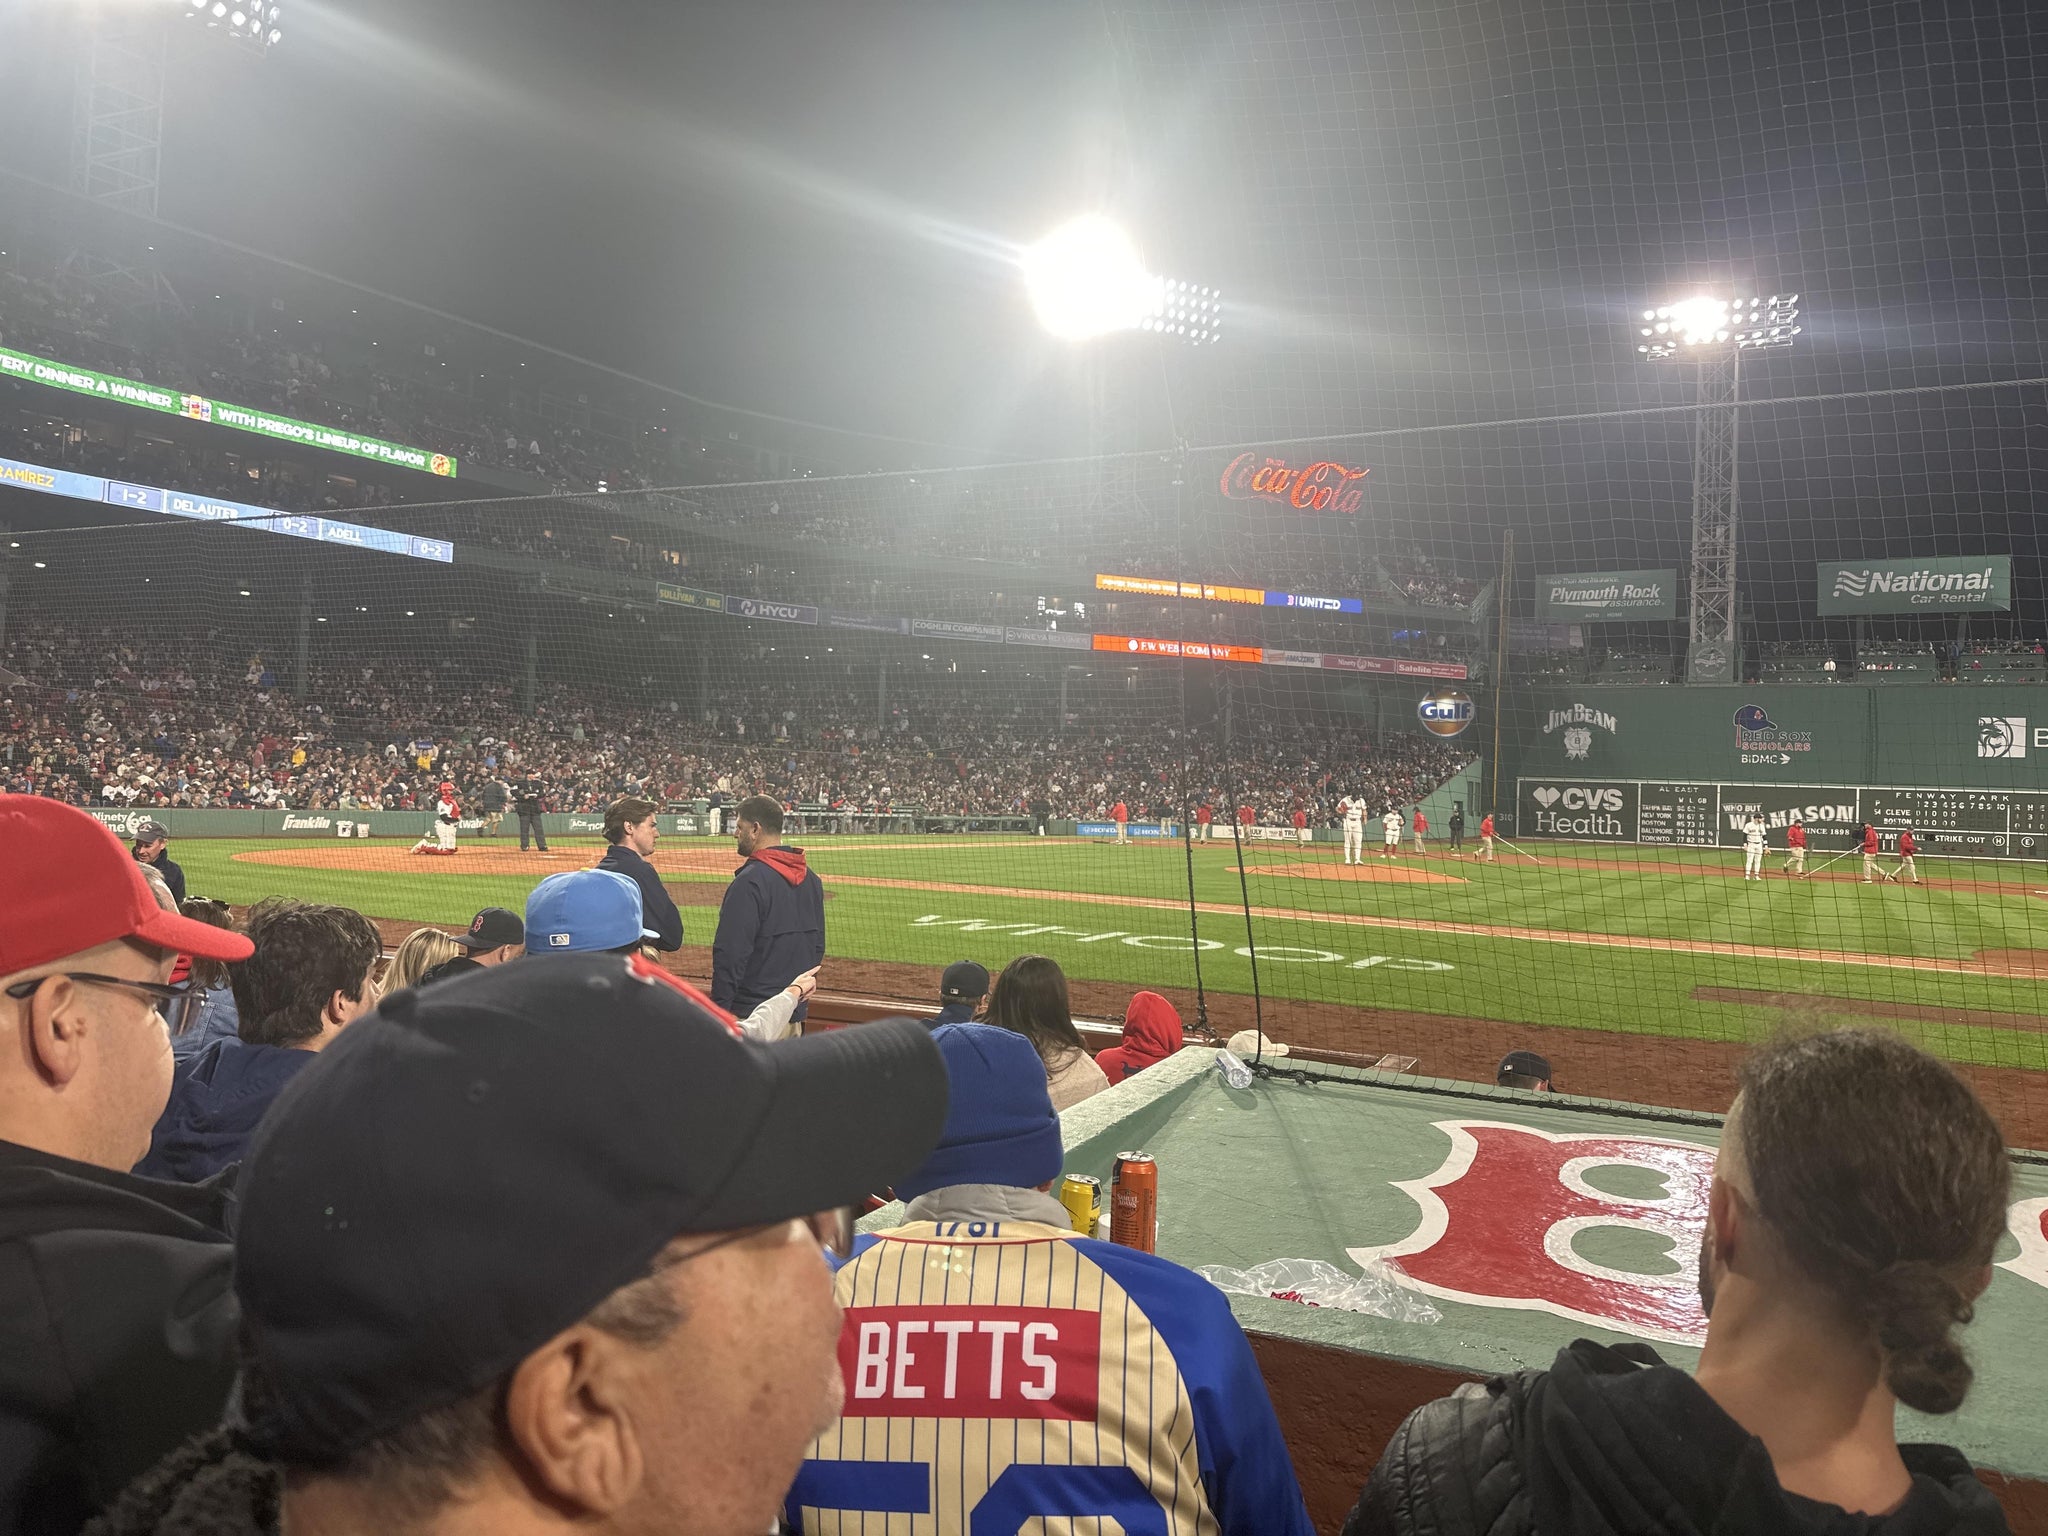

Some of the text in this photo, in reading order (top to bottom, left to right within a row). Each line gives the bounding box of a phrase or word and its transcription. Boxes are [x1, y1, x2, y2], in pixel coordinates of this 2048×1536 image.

[34, 363, 94, 390] DINNER
[96, 380, 109, 394] A
[110, 382, 172, 408] WINNER
[218, 407, 425, 467] WITH PREGO'S LINEUP OF FLAVOR
[1220, 451, 1370, 513] Coca-Cola
[122, 489, 147, 505] 1-2
[328, 527, 363, 542] ADELL
[1868, 567, 1993, 593] National
[1550, 584, 1661, 603] Plymouth Rock
[1910, 592, 1986, 604] Car Rental
[1298, 594, 1341, 610] UNITED
[1610, 598, 1661, 608] assurance
[759, 604, 798, 618] HYCU
[1420, 702, 1471, 719] Gulf
[1544, 703, 1617, 735] JIM BEAM
[1742, 731, 1812, 742] RED SOX
[1742, 742, 1811, 752] SCHOLARS
[1562, 787, 1623, 811] CVS
[1895, 792, 2009, 802] FENWAY PARK
[1723, 804, 1761, 812] WHO BUT
[1885, 808, 1911, 816] CLEVE
[91, 812, 128, 822] Ninety
[1498, 813, 1513, 822] 310
[1535, 811, 1623, 836] Health
[1769, 805, 1855, 829] MASON
[101, 822, 126, 832] ine
[1830, 828, 1850, 836] 1898
[909, 914, 1454, 971] WHOOP
[854, 1320, 1060, 1401] BETTS
